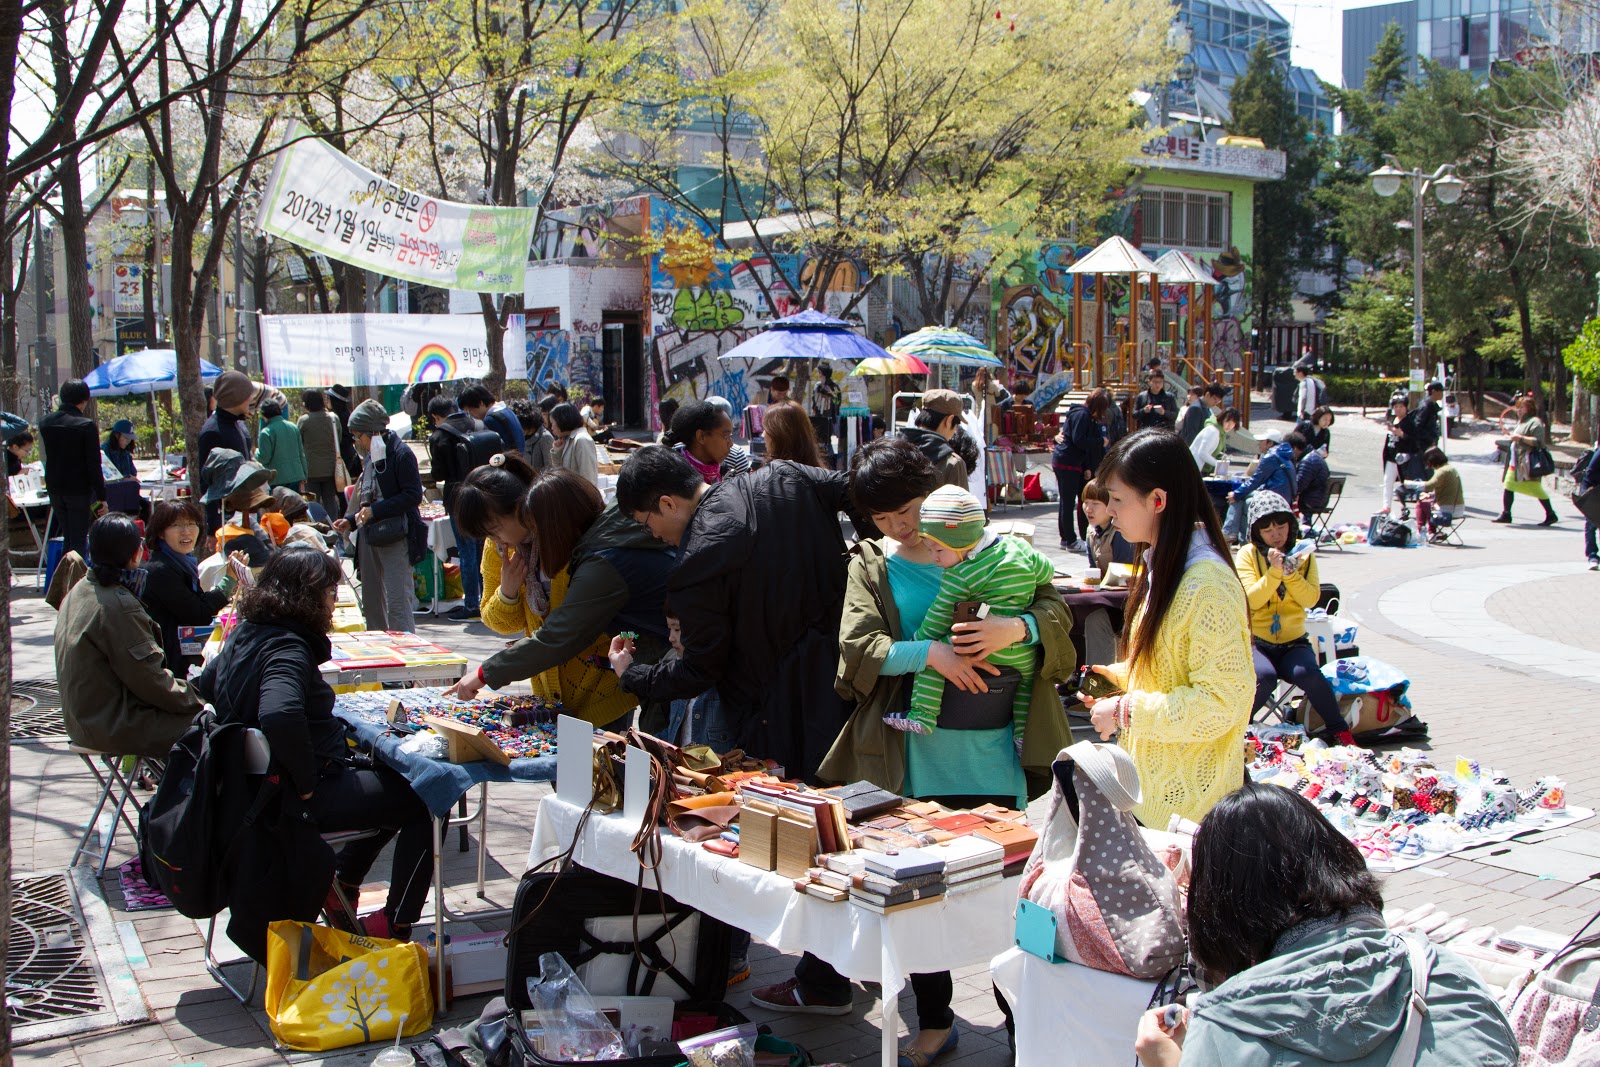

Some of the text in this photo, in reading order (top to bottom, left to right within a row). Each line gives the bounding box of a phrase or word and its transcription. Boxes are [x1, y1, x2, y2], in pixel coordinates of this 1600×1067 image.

[367, 179, 420, 223] 이 공원은
[282, 190, 332, 233] 2012년
[334, 208, 358, 244] 1월
[359, 219, 396, 257] 1일부터
[118, 281, 140, 297] 23
[119, 331, 141, 339] BLUE
[335, 345, 364, 363] 희망이
[368, 346, 396, 362] 시작되는
